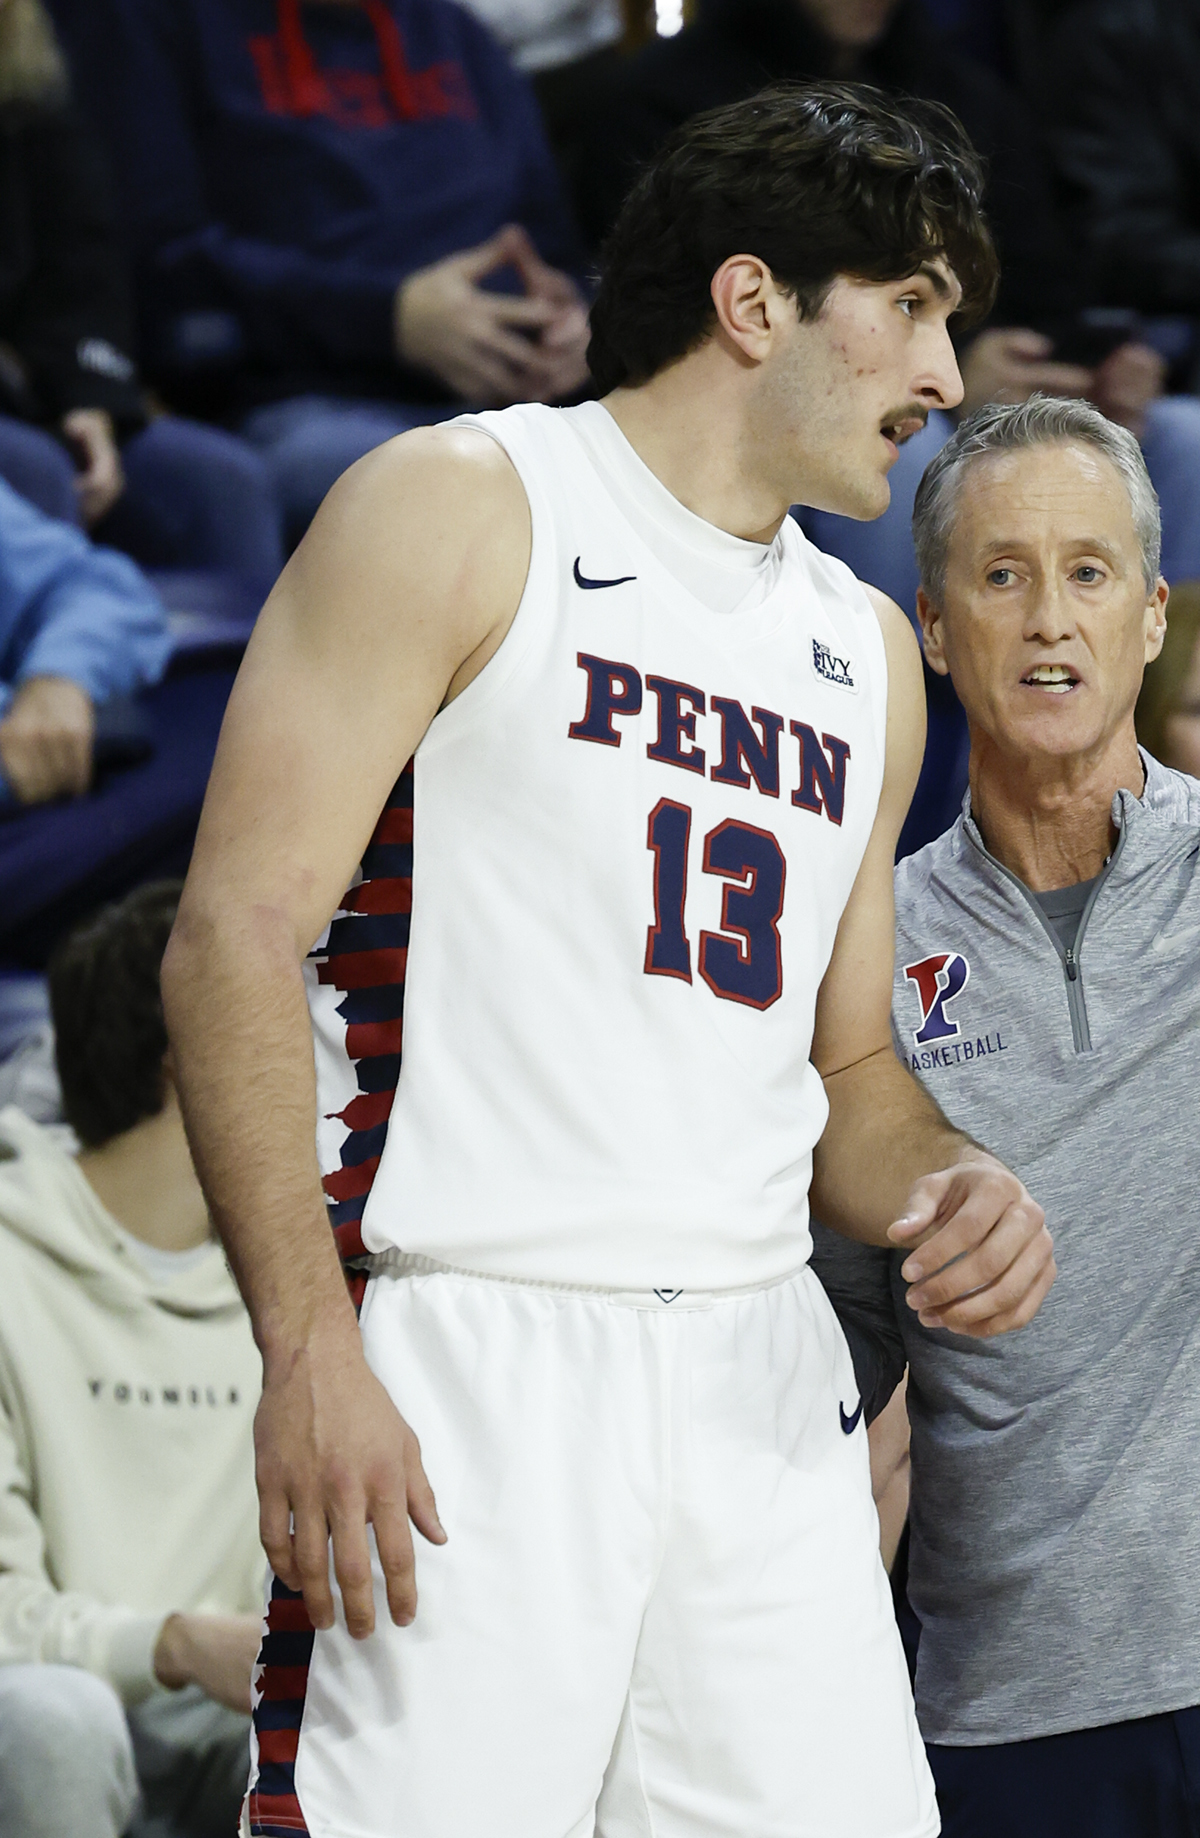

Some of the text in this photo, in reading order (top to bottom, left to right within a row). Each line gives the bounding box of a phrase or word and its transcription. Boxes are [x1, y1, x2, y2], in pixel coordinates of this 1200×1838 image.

[820, 651, 851, 677] IVY
[822, 669, 854, 687] LEAGUE
[568, 651, 851, 827] PENN
[643, 797, 786, 1011] 13
[903, 952, 970, 1047] P
